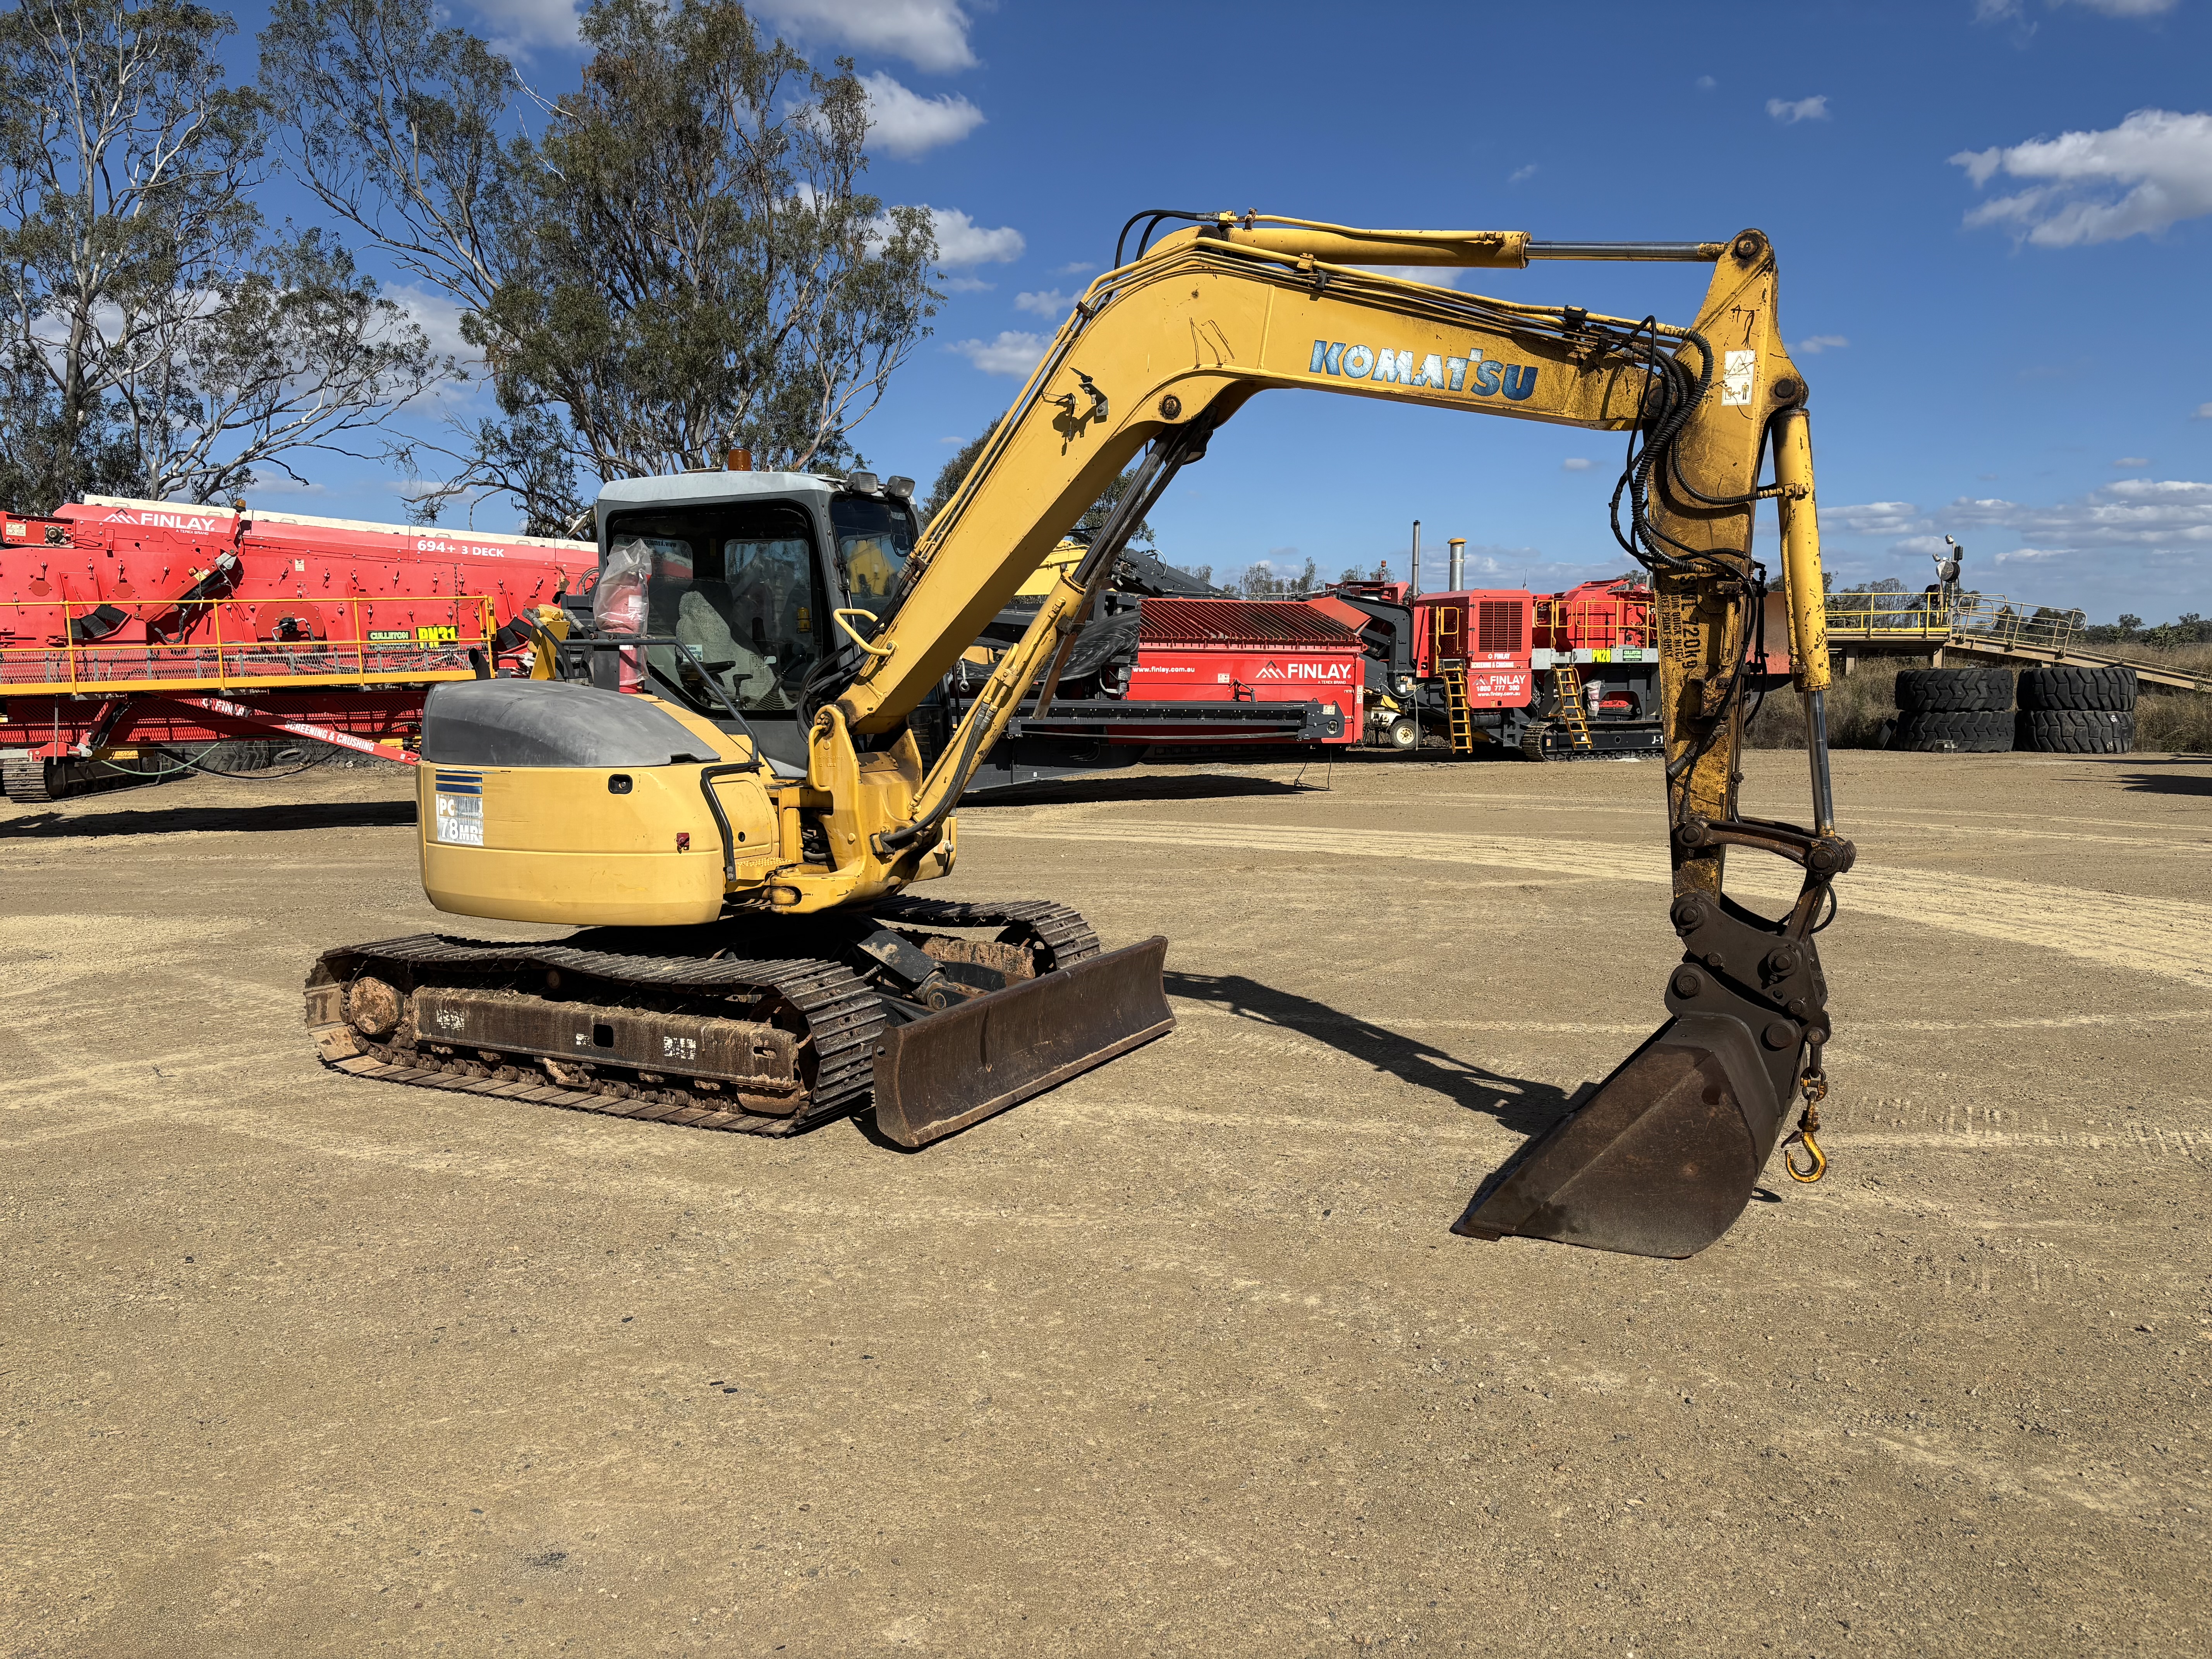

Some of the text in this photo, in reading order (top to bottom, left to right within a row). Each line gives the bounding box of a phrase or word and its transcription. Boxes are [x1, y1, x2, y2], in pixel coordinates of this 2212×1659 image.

[1309, 340, 1538, 401] KOMATSU
[141, 513, 215, 531] FINLAY
[417, 540, 505, 558] 694+ 3 DECK
[1662, 612, 1671, 635] POINT
[1673, 612, 1682, 635] QUICK
[1664, 639, 1673, 658] ONLY
[1682, 617, 1701, 669] 720kg
[1592, 649, 1611, 663] PN28
[1288, 664, 1351, 678] FINLAY
[1490, 675, 1526, 685] FINLAY
[285, 720, 375, 752] SCREENING & CRUSHING
[440, 798, 455, 816] PC
